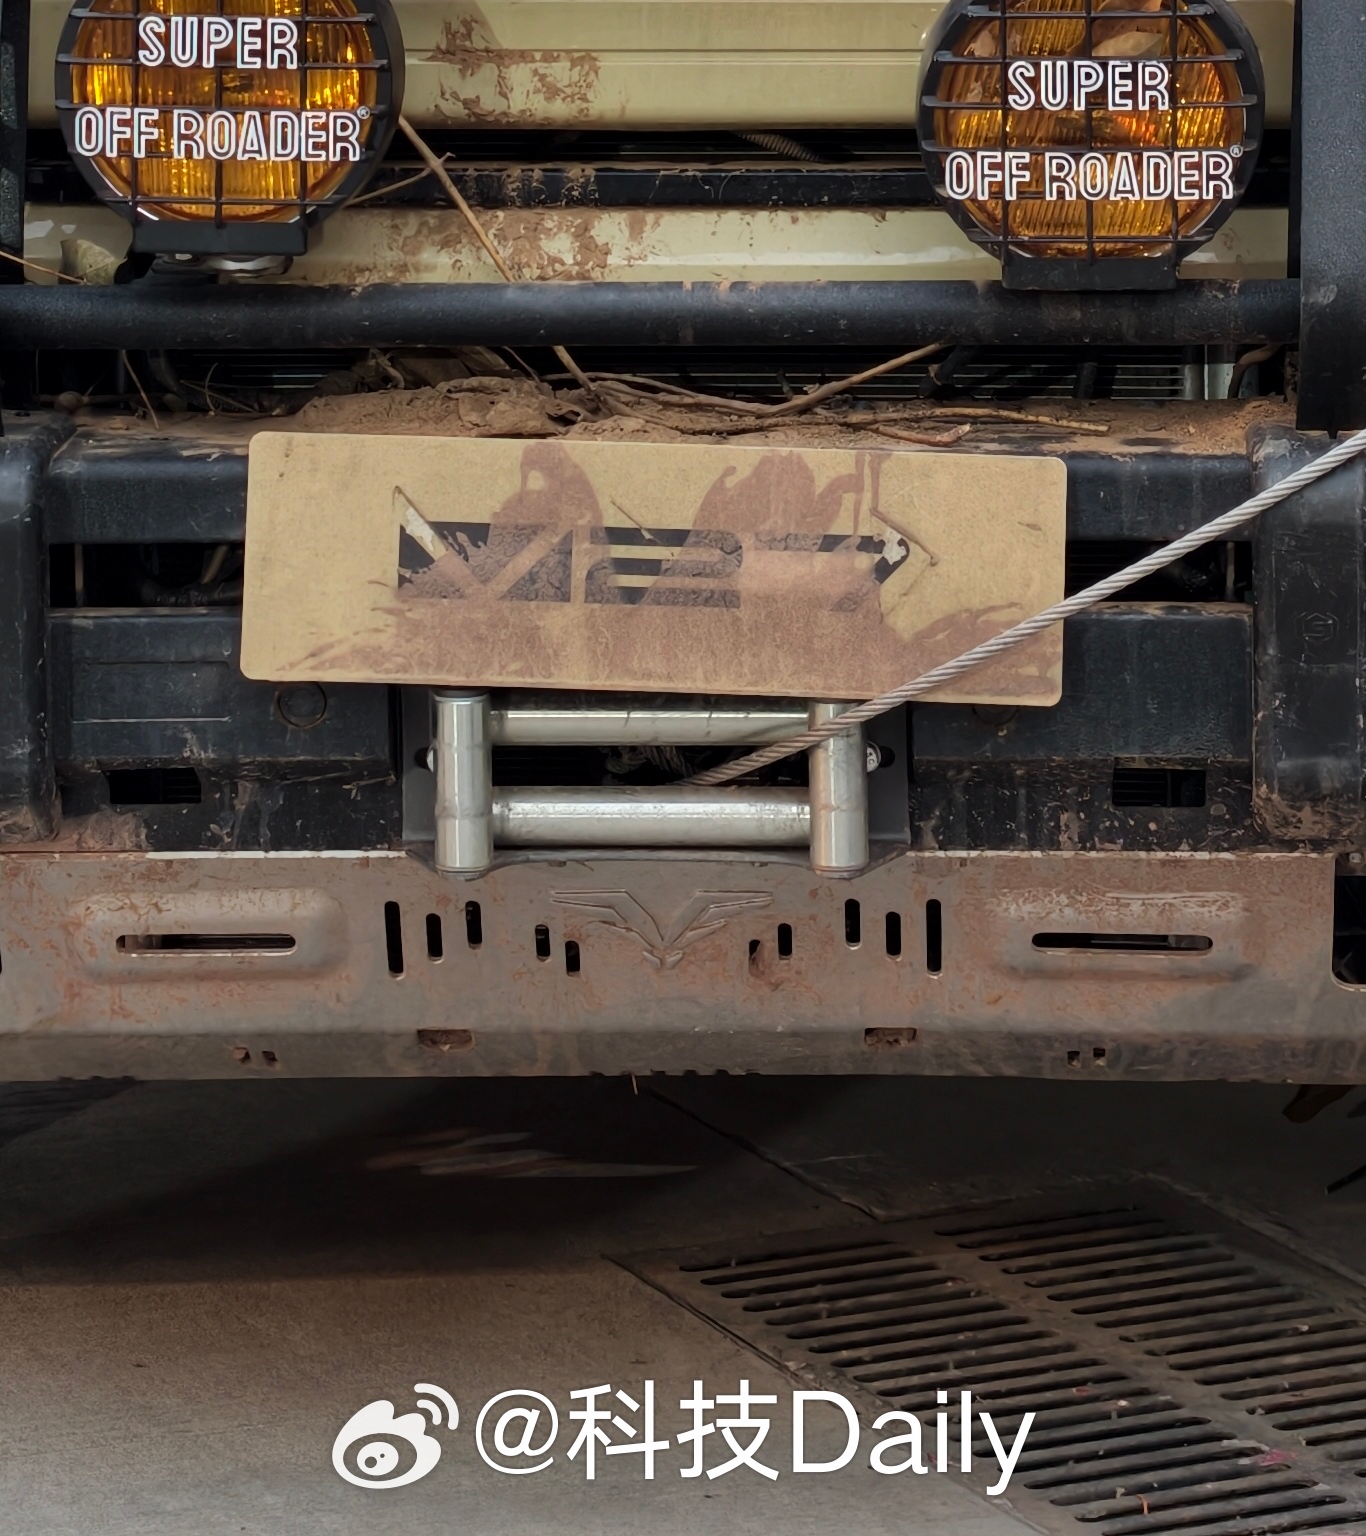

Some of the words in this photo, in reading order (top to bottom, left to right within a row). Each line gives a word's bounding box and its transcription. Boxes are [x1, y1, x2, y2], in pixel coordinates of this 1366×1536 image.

[138, 16, 299, 69] SUPER
[1008, 60, 1170, 111] SUPER
[75, 106, 160, 158] OFF
[945, 151, 1031, 201] OFF
